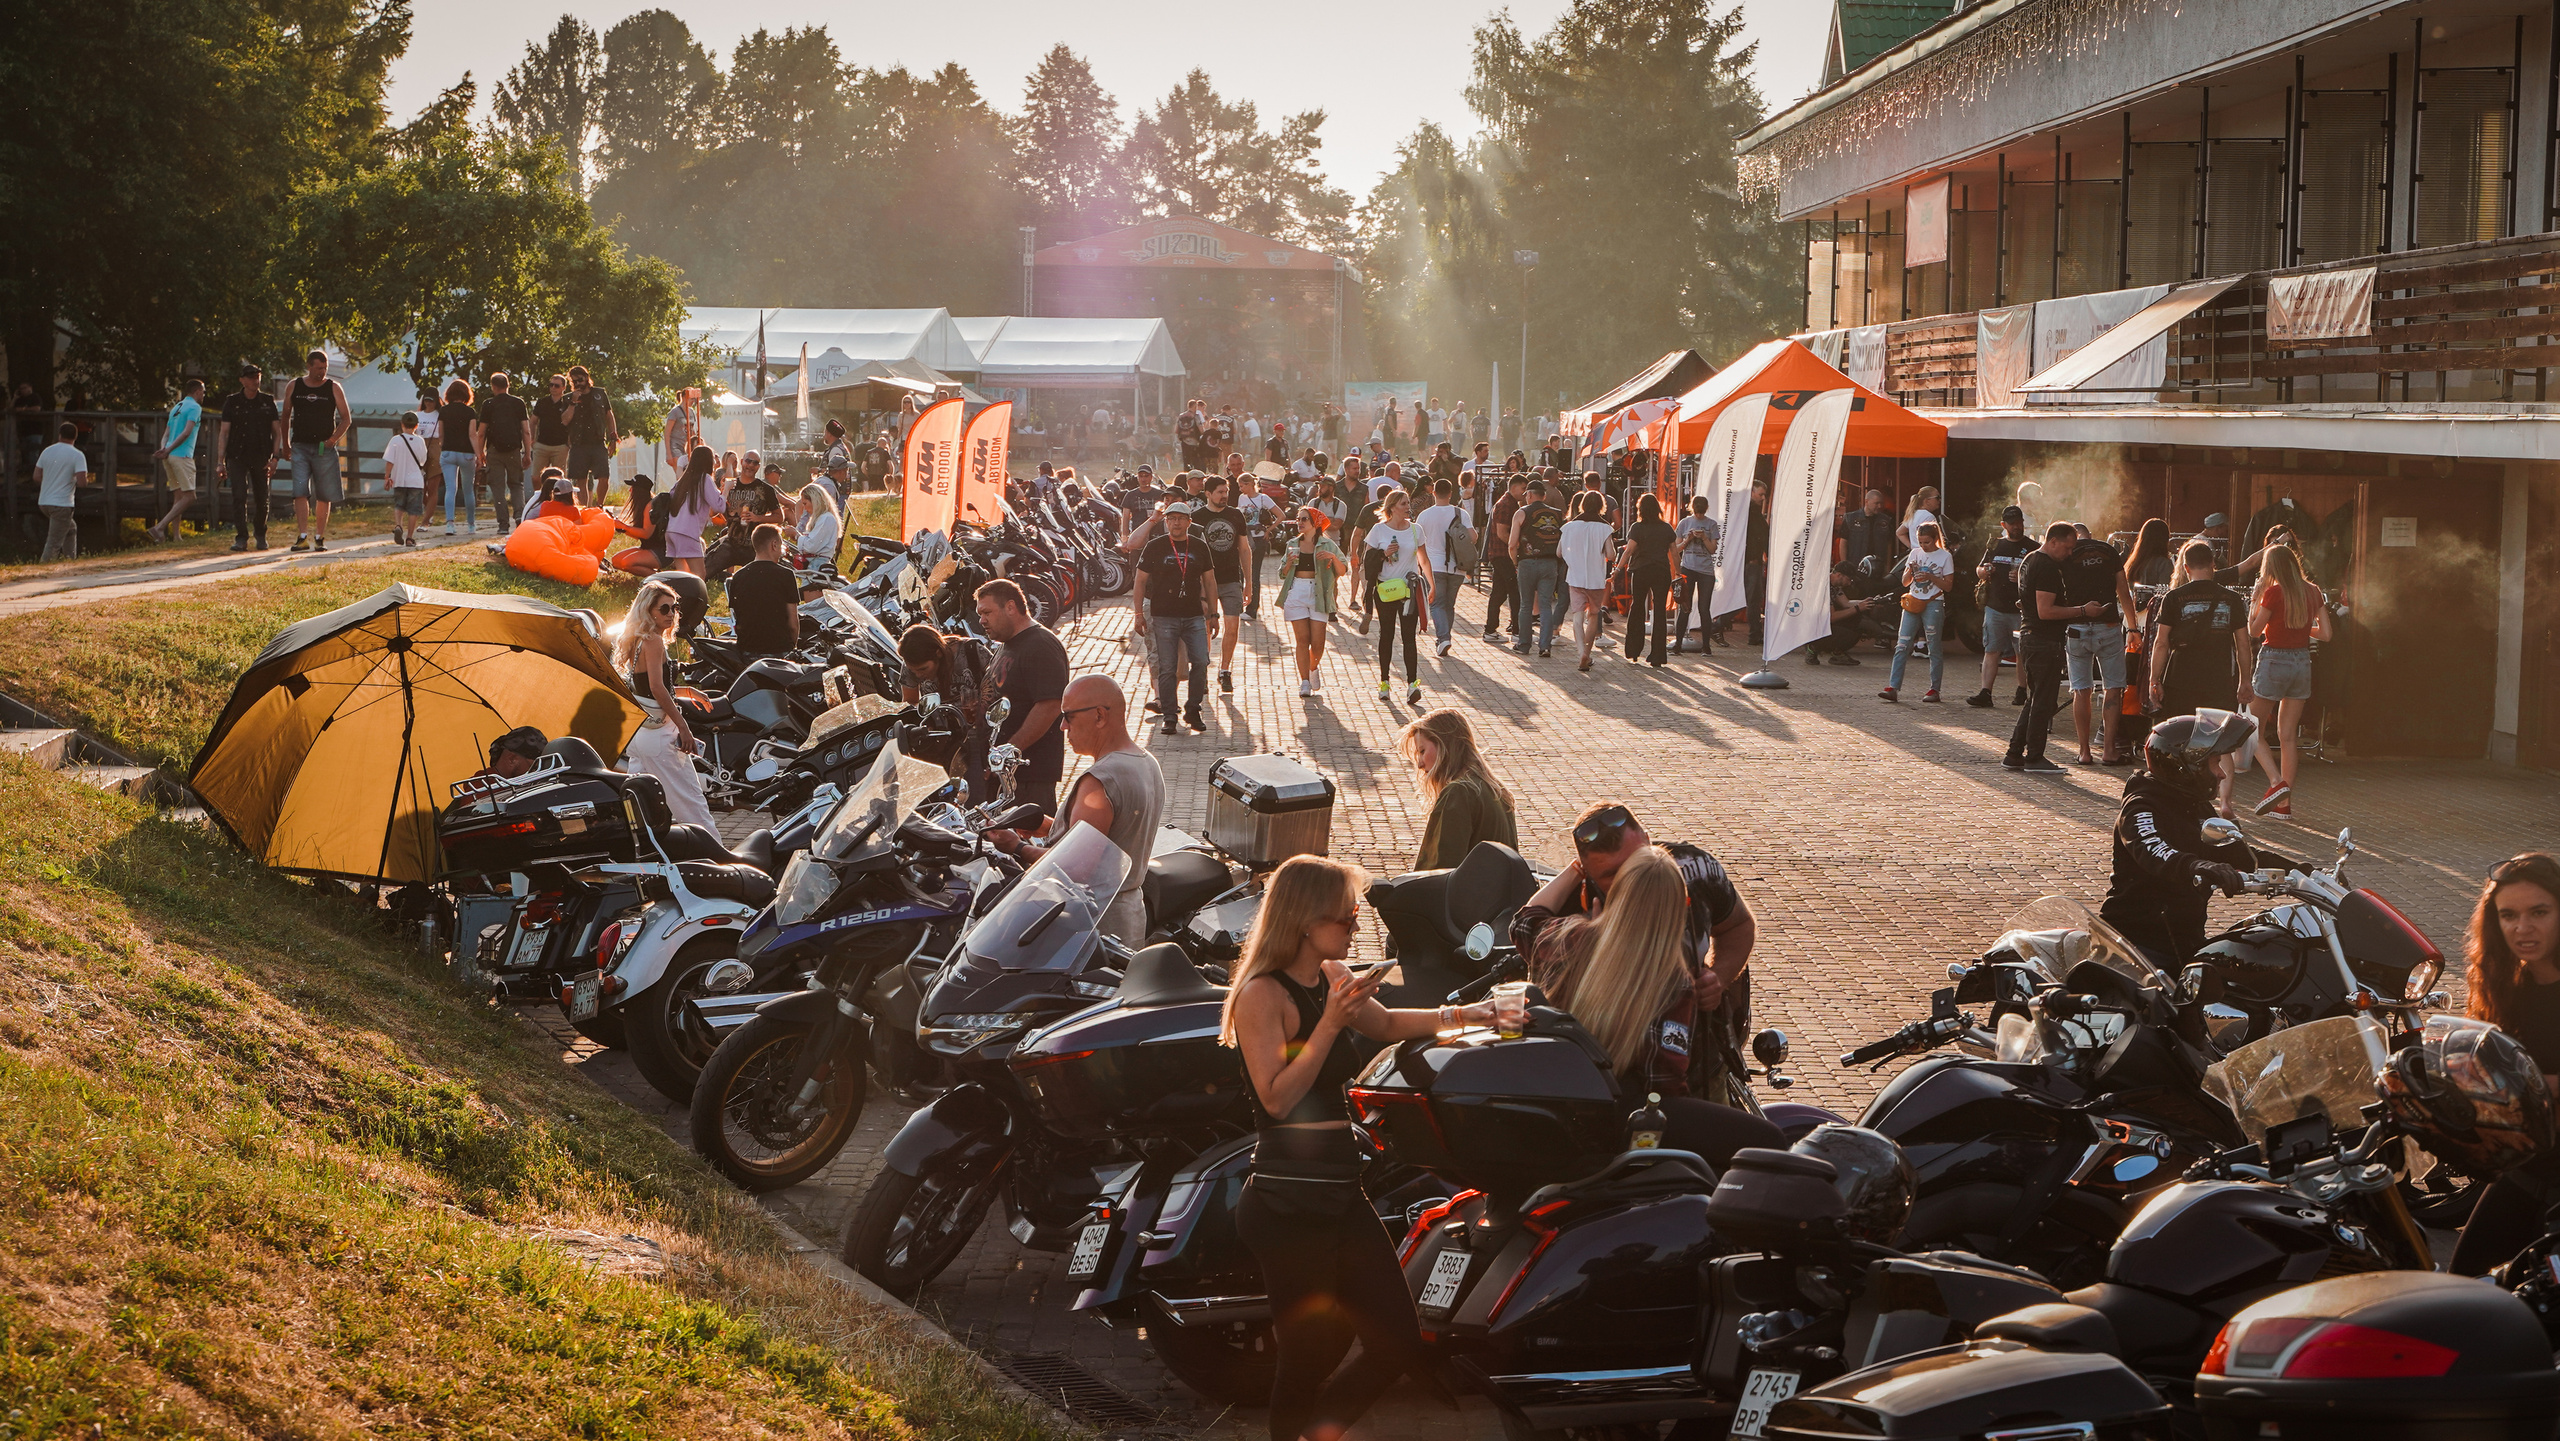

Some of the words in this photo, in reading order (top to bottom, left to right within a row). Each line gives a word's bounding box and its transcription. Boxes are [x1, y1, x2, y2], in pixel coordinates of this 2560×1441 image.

[1728, 429, 1738, 465] Motorrad
[1807, 431, 1818, 472] Motorrad
[916, 440, 936, 496] KTM
[971, 438, 989, 484] KTM
[1725, 465, 1734, 487] BMW
[1806, 473, 1814, 497] BMW
[1724, 488, 1733, 513] дилер
[1804, 499, 1813, 527] дилер
[525, 931, 546, 946] 9933
[577, 978, 596, 996] 6900
[1083, 1227, 1106, 1246] 4048
[1085, 1253, 1098, 1271] 50
[1438, 1254, 1466, 1275] 3883
[1440, 1285, 1456, 1305] 77
[1536, 1337, 1559, 1346] BMW
[1749, 1373, 1793, 1399] 2745
